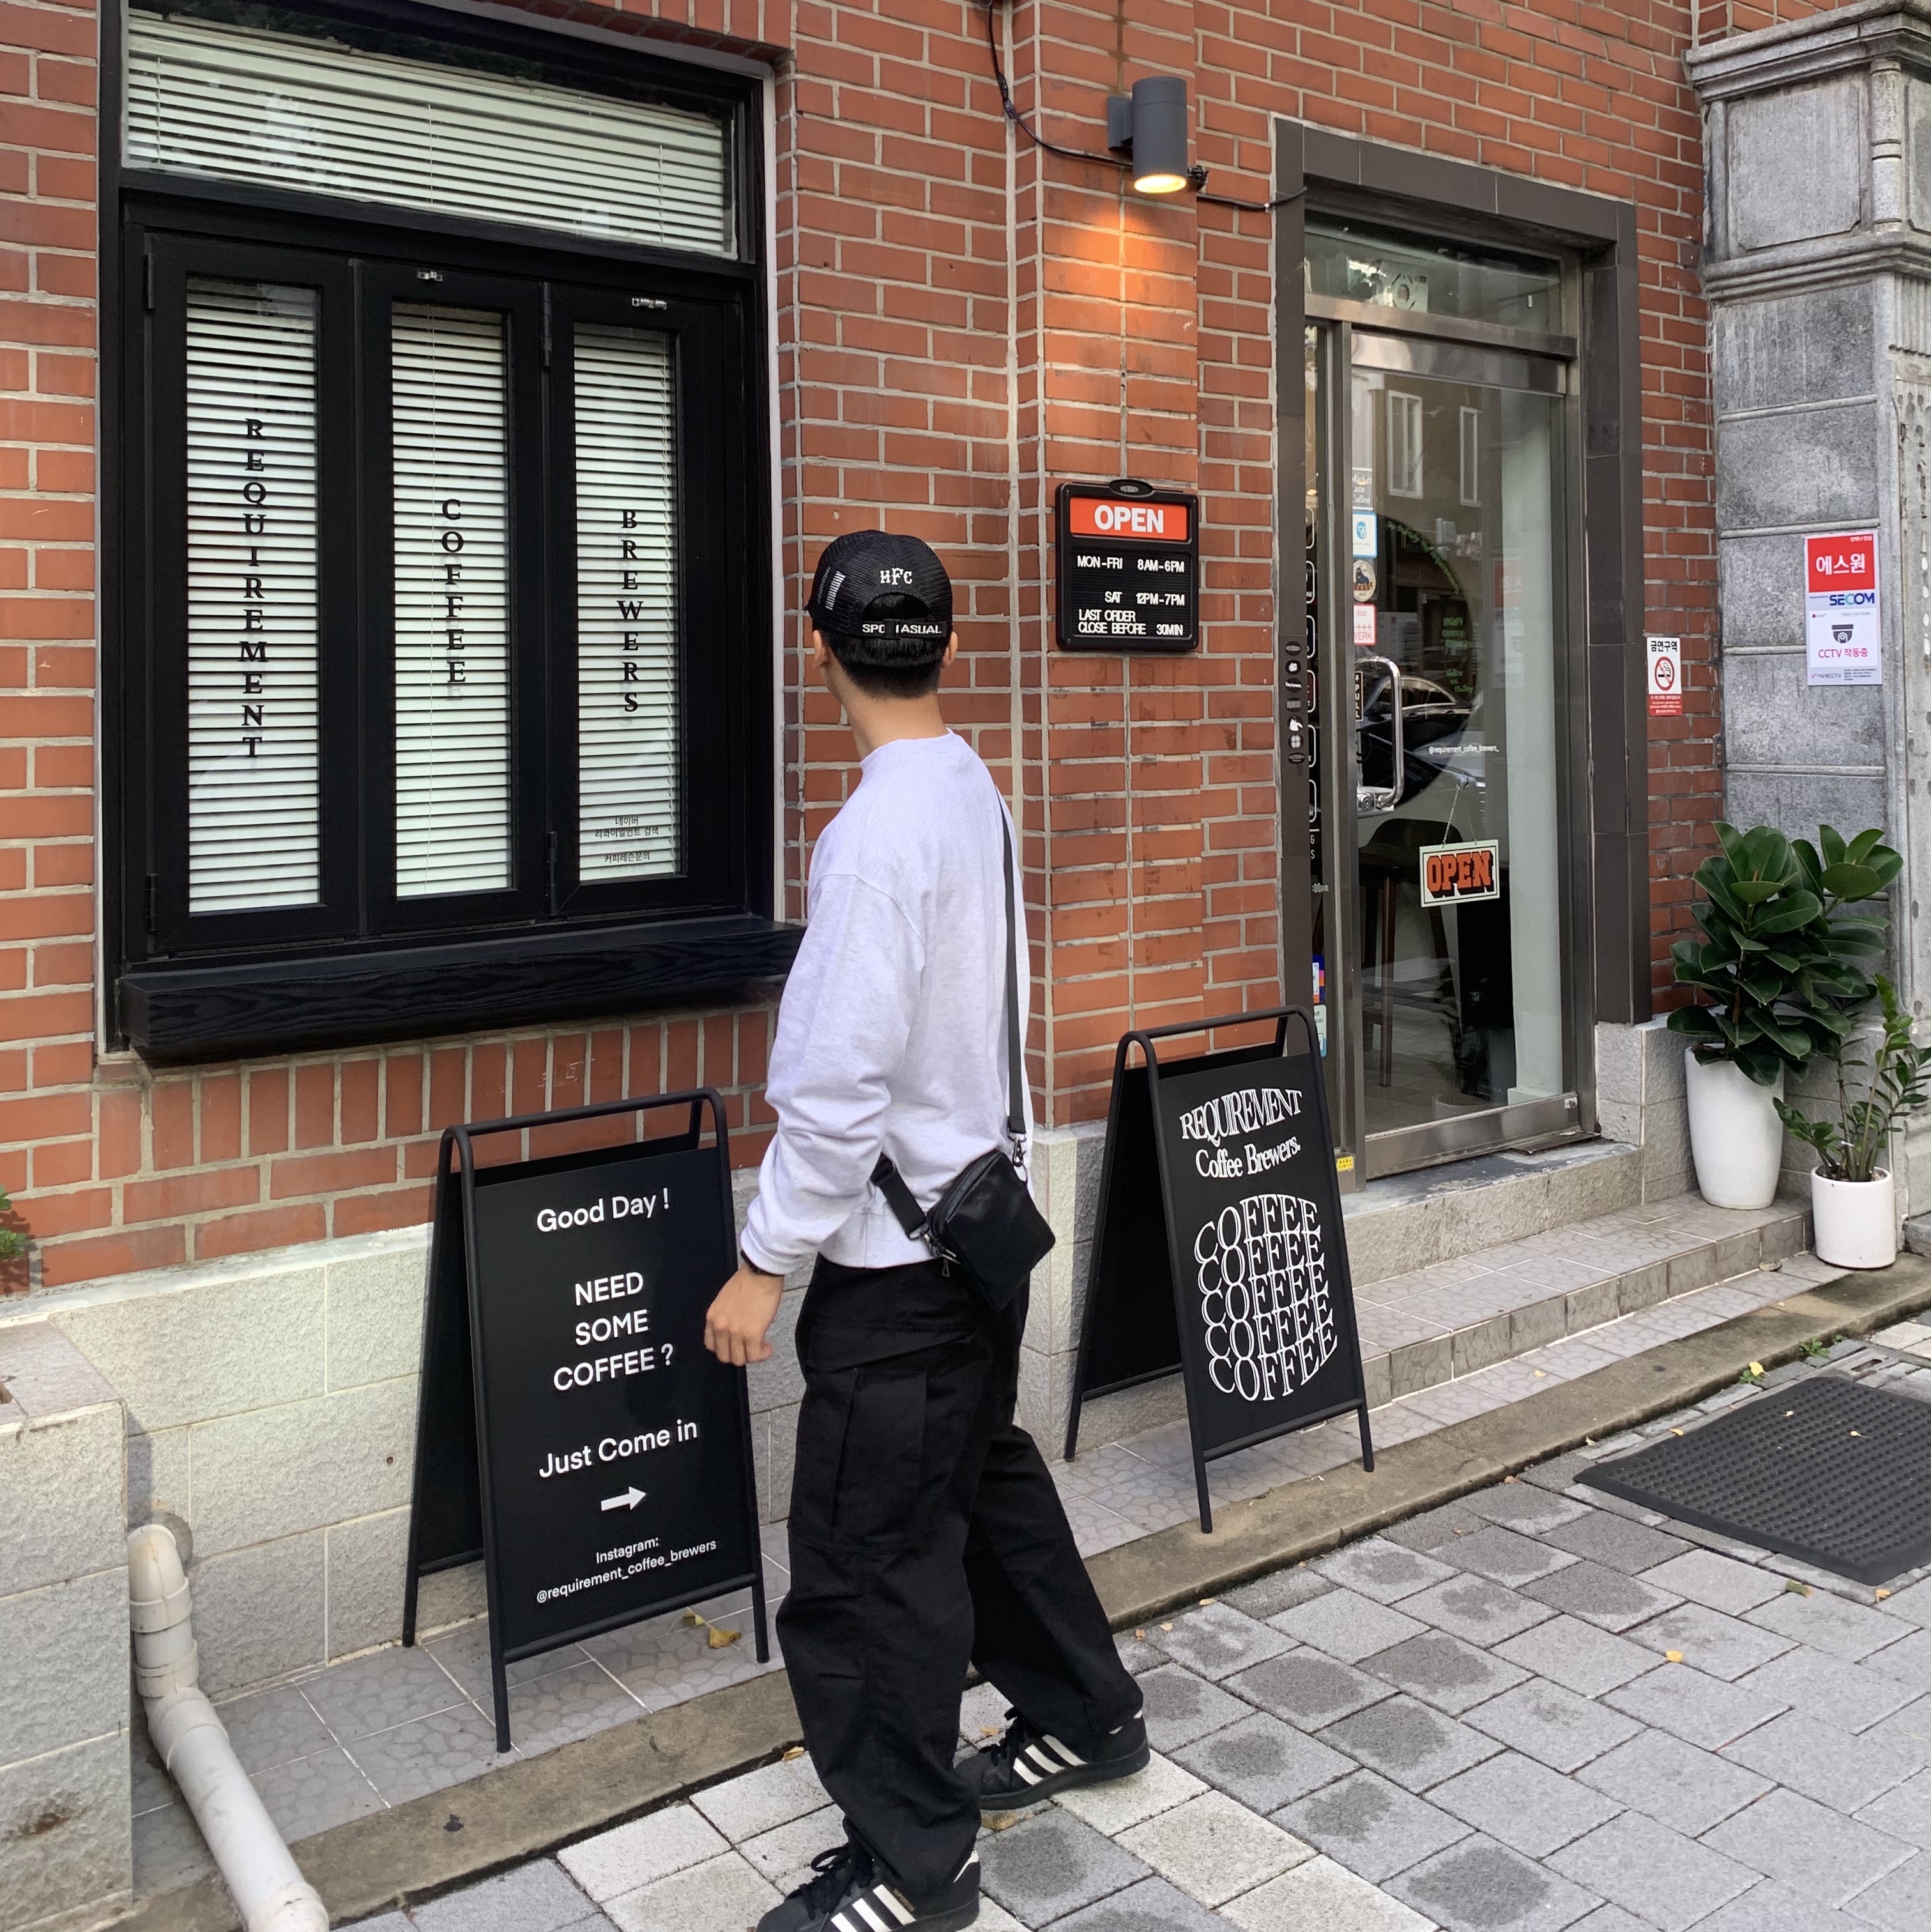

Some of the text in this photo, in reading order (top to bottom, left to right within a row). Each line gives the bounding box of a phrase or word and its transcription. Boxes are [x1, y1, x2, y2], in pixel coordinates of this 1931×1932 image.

[1094, 504, 1164, 533] OPEN
[1077, 556, 1184, 573] MON-FRI 8AM-6PM
[1815, 553, 1865, 576] 에스원
[238, 418, 268, 758] REQUIREMENT
[441, 498, 467, 684] COFFEE
[1104, 592, 1185, 606] SAT 12PM-7PM
[1829, 593, 1875, 606] SECOM
[617, 509, 643, 714] BREWERS
[1078, 622, 1183, 636] CLOSE BEFORE 30MIN
[1079, 609, 1136, 622] LAST ORDER
[1651, 640, 1677, 652] 금연구역
[1818, 648, 1868, 658] CCTV 작동중
[615, 816, 638, 825] 네이버
[644, 827, 659, 836] 검색
[604, 851, 650, 863] 커피레슨문의
[1426, 850, 1494, 898] OPEN
[1179, 1087, 1302, 1147] REQUIREMENT
[1195, 1135, 1301, 1179] Coffee Brewers.
[536, 1187, 670, 1232] Good Day !
[1194, 1193, 1321, 1264] COFFEE
[1198, 1230, 1325, 1294] COFFEE
[575, 1271, 644, 1306] NEED
[1202, 1262, 1329, 1328] COFFEE
[575, 1309, 649, 1346] SOME
[1205, 1292, 1333, 1360] COFFEE
[553, 1344, 673, 1392] COFFEE ?
[1209, 1323, 1338, 1402] COFFEE
[538, 1419, 698, 1479] Just Come in
[595, 1536, 659, 1565] Instagram:
[536, 1538, 716, 1604] @requirement_coffee_brewers
